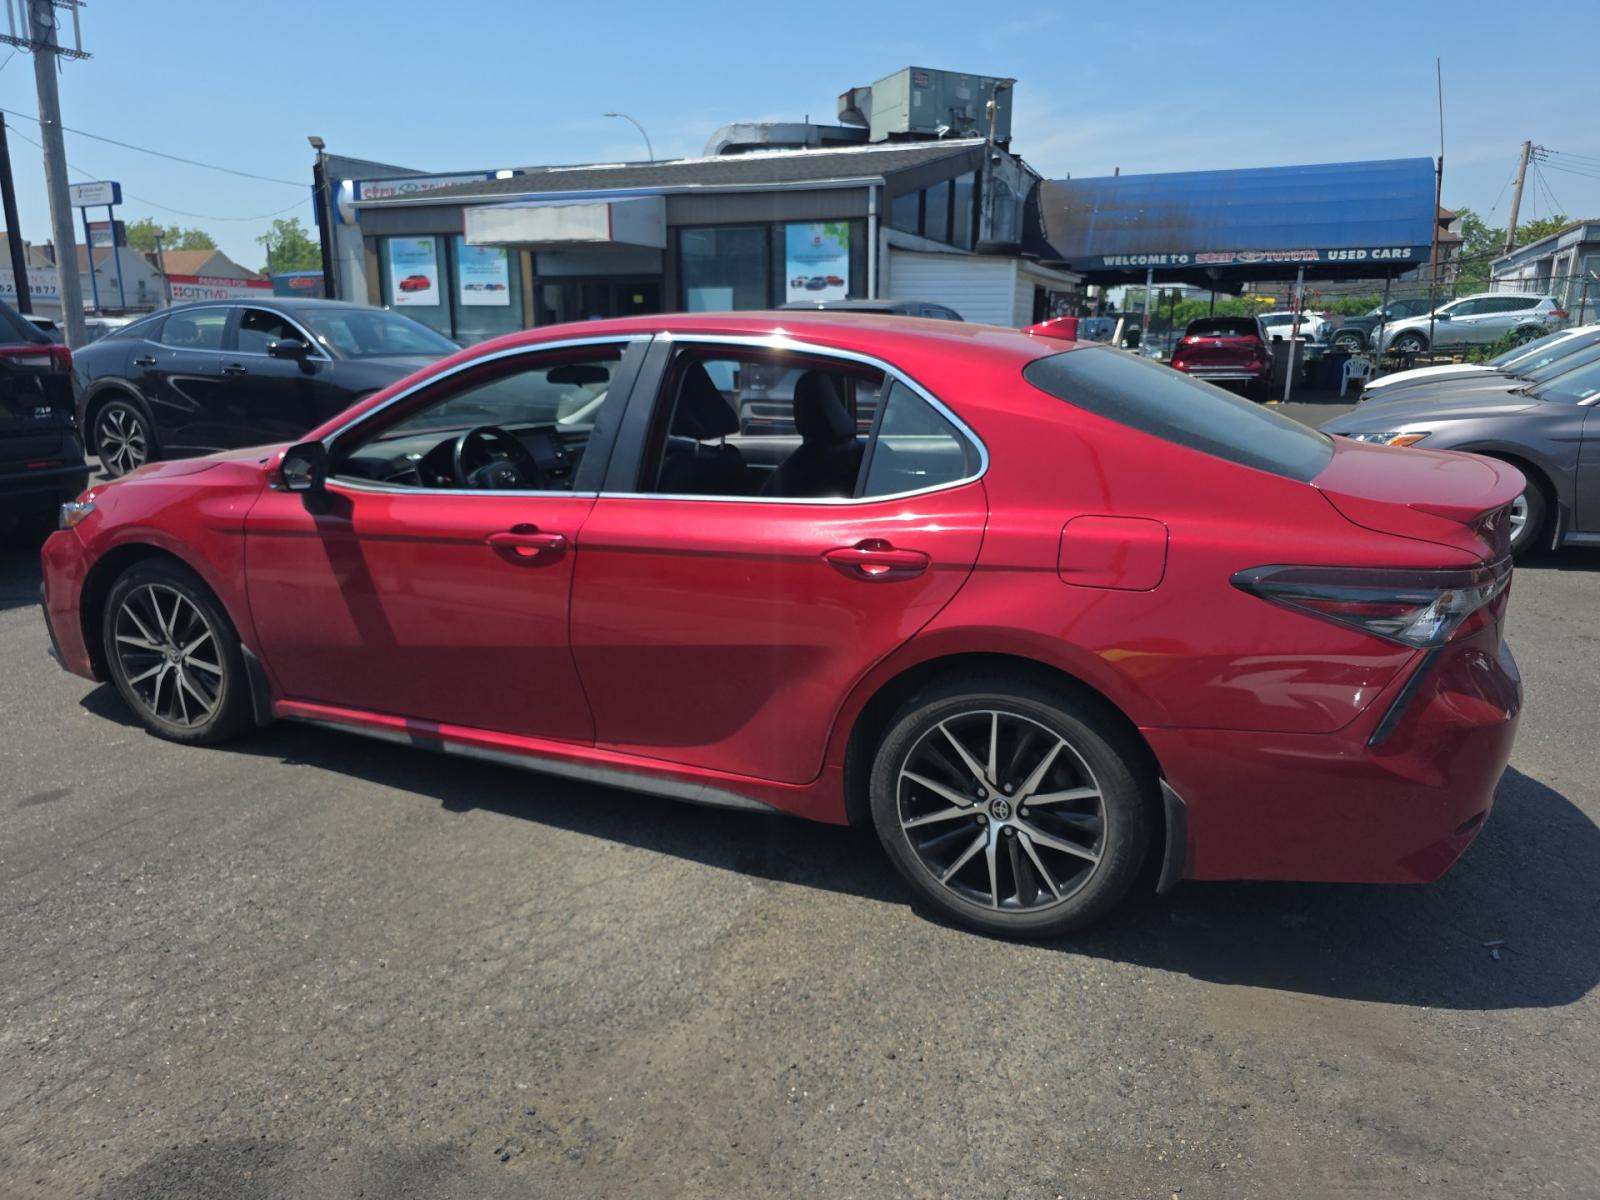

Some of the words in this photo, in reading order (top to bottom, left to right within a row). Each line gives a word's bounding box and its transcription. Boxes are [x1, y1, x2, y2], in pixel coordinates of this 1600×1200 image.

[1103, 255, 1168, 266] WELCOME
[1170, 254, 1189, 264] TO
[1264, 250, 1320, 262] TOYOTA
[1327, 250, 1367, 261] USED
[1371, 248, 1412, 259] CARS
